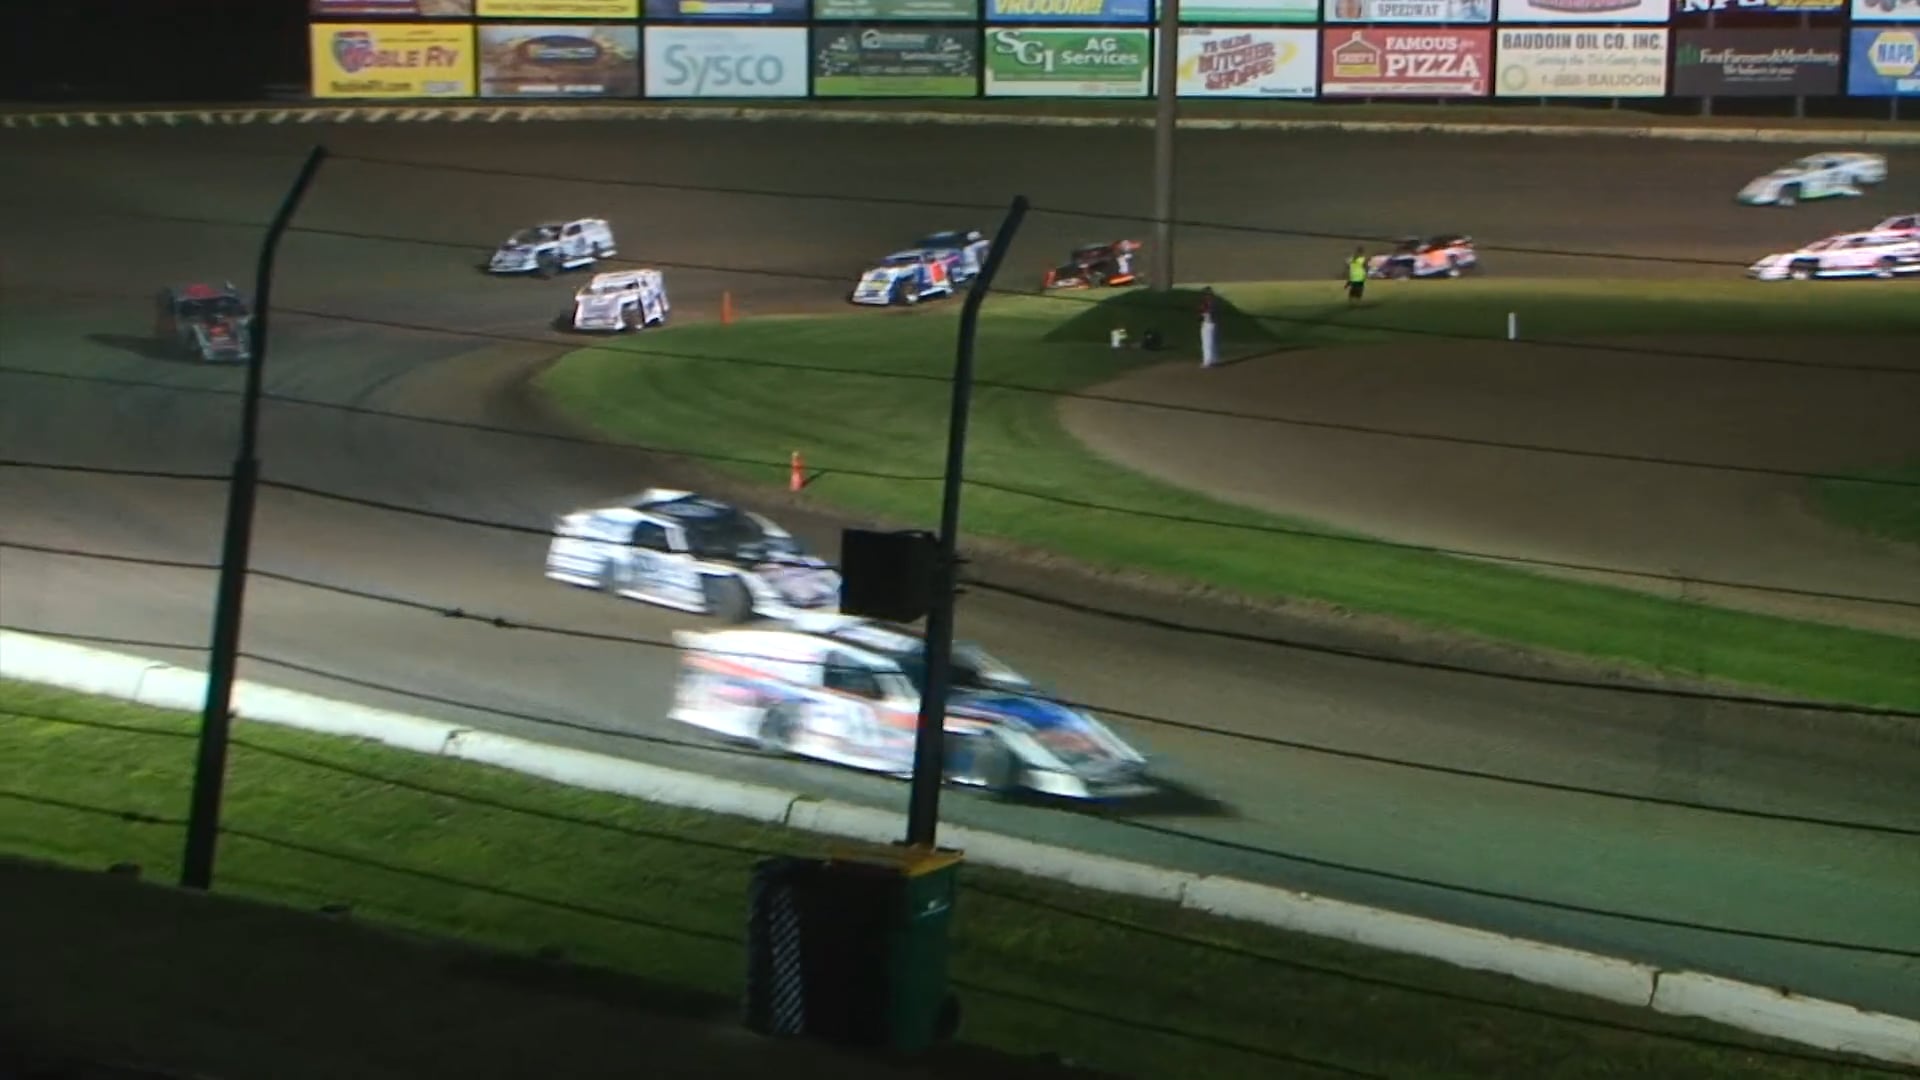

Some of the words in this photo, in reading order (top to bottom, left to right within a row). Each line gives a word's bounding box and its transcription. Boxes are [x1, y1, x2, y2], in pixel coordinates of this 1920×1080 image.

[1378, 3, 1440, 17] SPEEDWAY
[1085, 37, 1117, 51] AG
[1386, 37, 1457, 50] FAMOUS
[1502, 33, 1572, 50] BAUDOIN
[1576, 33, 1599, 49] OIL
[1603, 33, 1629, 50] CO.
[1633, 34, 1664, 50] INC.
[996, 31, 1054, 72] SGI
[1061, 51, 1138, 65] Services
[1878, 44, 1914, 62] NAPA
[664, 44, 783, 96] Sysco
[1385, 54, 1480, 77] PIZZA
